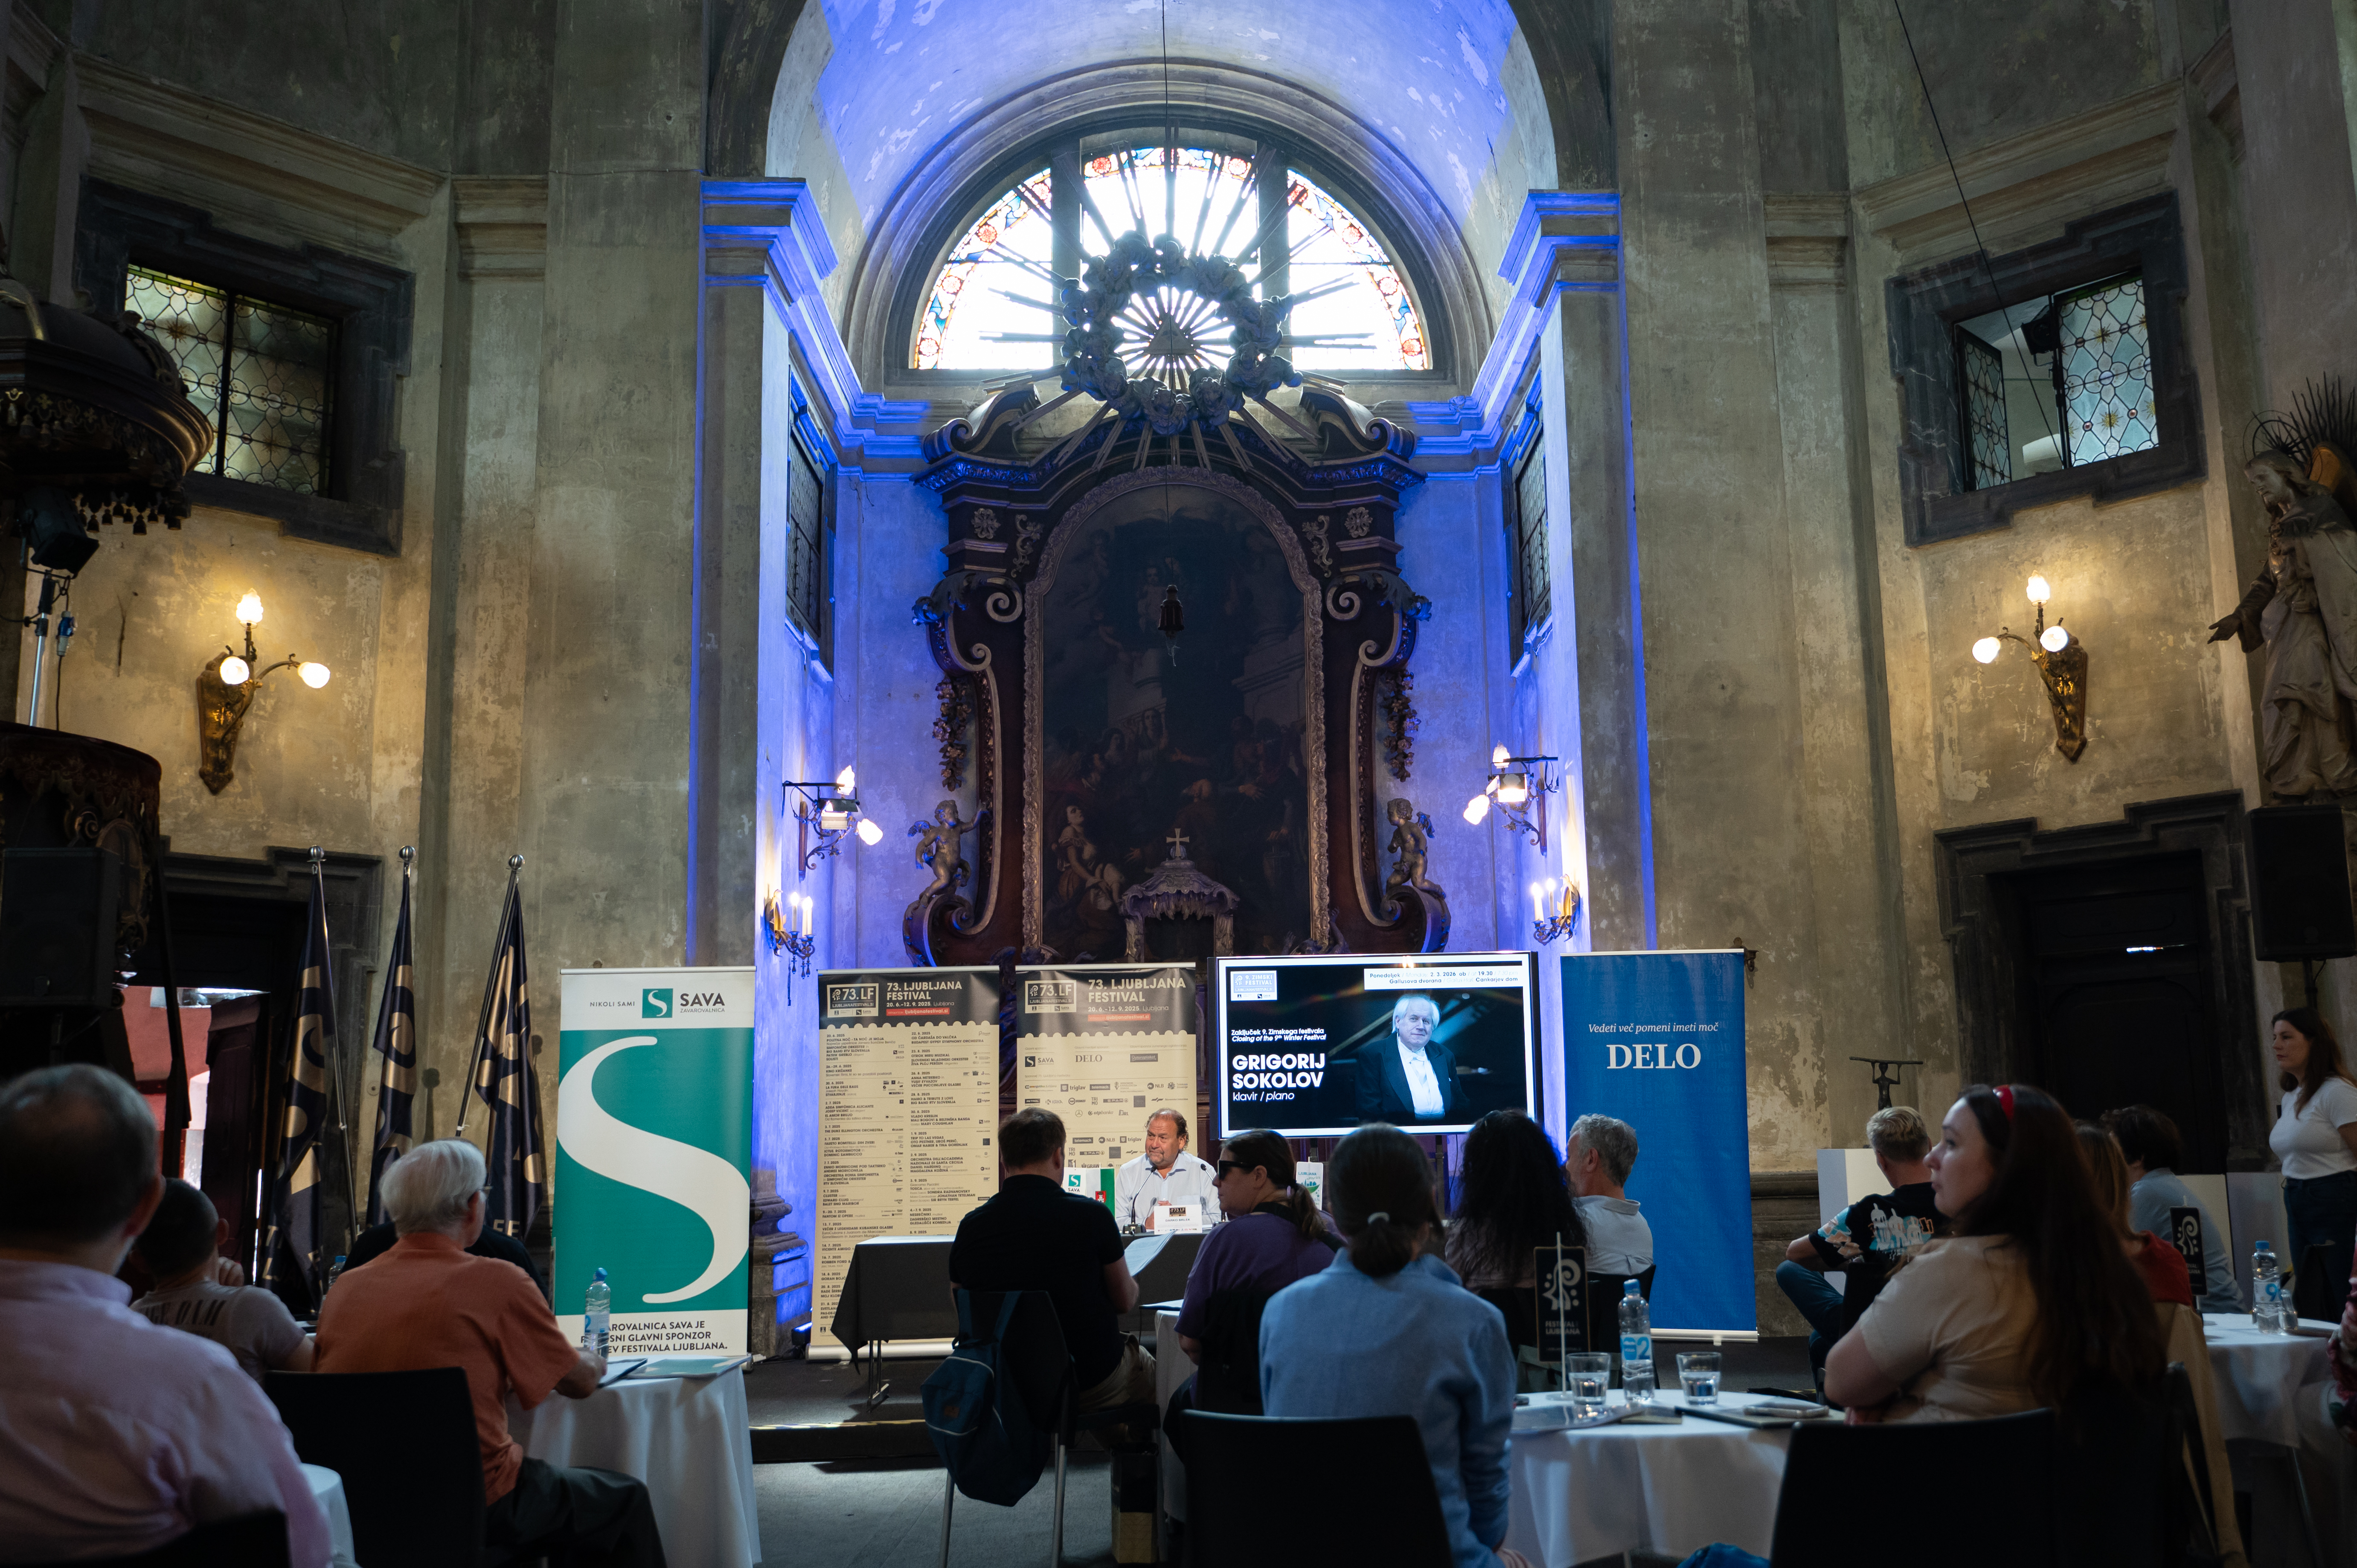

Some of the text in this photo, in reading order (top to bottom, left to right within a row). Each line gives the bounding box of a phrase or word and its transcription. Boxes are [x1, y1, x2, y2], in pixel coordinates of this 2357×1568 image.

[887, 981, 962, 991] 73. LJUBLJANA
[1040, 984, 1072, 996] 73. LF
[1089, 978, 1186, 990] 73. LJUBLJANA
[680, 993, 725, 1006] SAVA
[843, 988, 874, 1000] 73. LF
[887, 991, 931, 1000] FESTIVAL
[1088, 991, 1145, 1002] FESTIVAL
[1589, 1022, 1718, 1034] Vedeti več pomeni imeti moč
[1232, 1053, 1325, 1070] GRIGORIJ
[1606, 1043, 1701, 1069] DELO
[1233, 1072, 1323, 1089] SOKOLOV
[1233, 1092, 1258, 1101] klavir
[1266, 1092, 1294, 1102] piano
[608, 1323, 666, 1331] ROVALNICA
[628, 1333, 663, 1342] GLAVNI
[666, 1332, 711, 1340] SPONZOR
[622, 1344, 670, 1353] FESTIVALA
[673, 1342, 727, 1351] LJUBLJANA.
